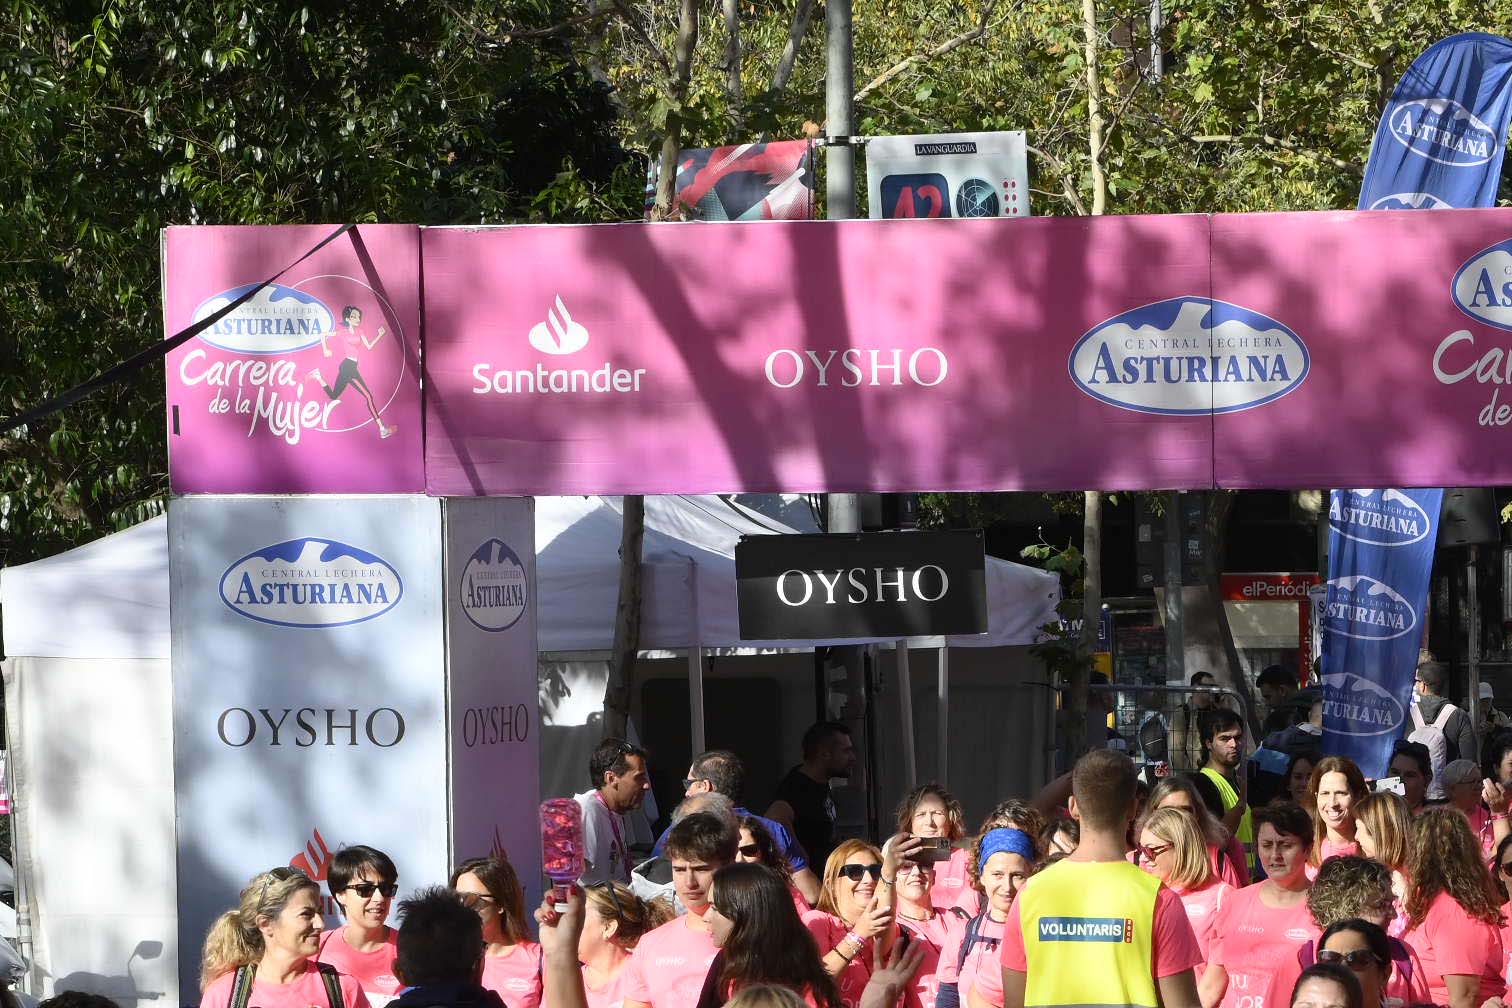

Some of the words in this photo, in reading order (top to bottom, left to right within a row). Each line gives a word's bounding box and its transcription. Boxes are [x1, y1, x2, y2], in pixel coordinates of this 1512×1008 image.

[205, 314, 322, 336] ASTURIANA
[1125, 338, 1199, 350] CENTRAL
[1208, 337, 1282, 348] LECHERA
[180, 350, 296, 387] Carrera
[472, 363, 646, 396] Santander
[764, 347, 948, 388] OYSHO
[1088, 342, 1291, 385] ASTURIANA
[208, 389, 231, 414] de
[235, 386, 251, 413] la
[248, 383, 342, 444] Mujer
[1478, 389, 1512, 426] de
[234, 571, 389, 605] ASTURIANA
[261, 569, 321, 579] CENTRAL
[324, 568, 383, 578] LECHERA
[466, 573, 523, 608] ASTURIANA
[776, 565, 950, 606] OYSHO
[1327, 601, 1405, 630] STURIANA
[217, 707, 406, 748] OYSHO
[463, 703, 529, 748] OYSHO
[1322, 699, 1394, 726] TURIANA
[1040, 922, 1122, 937] VOLUNTARIS
